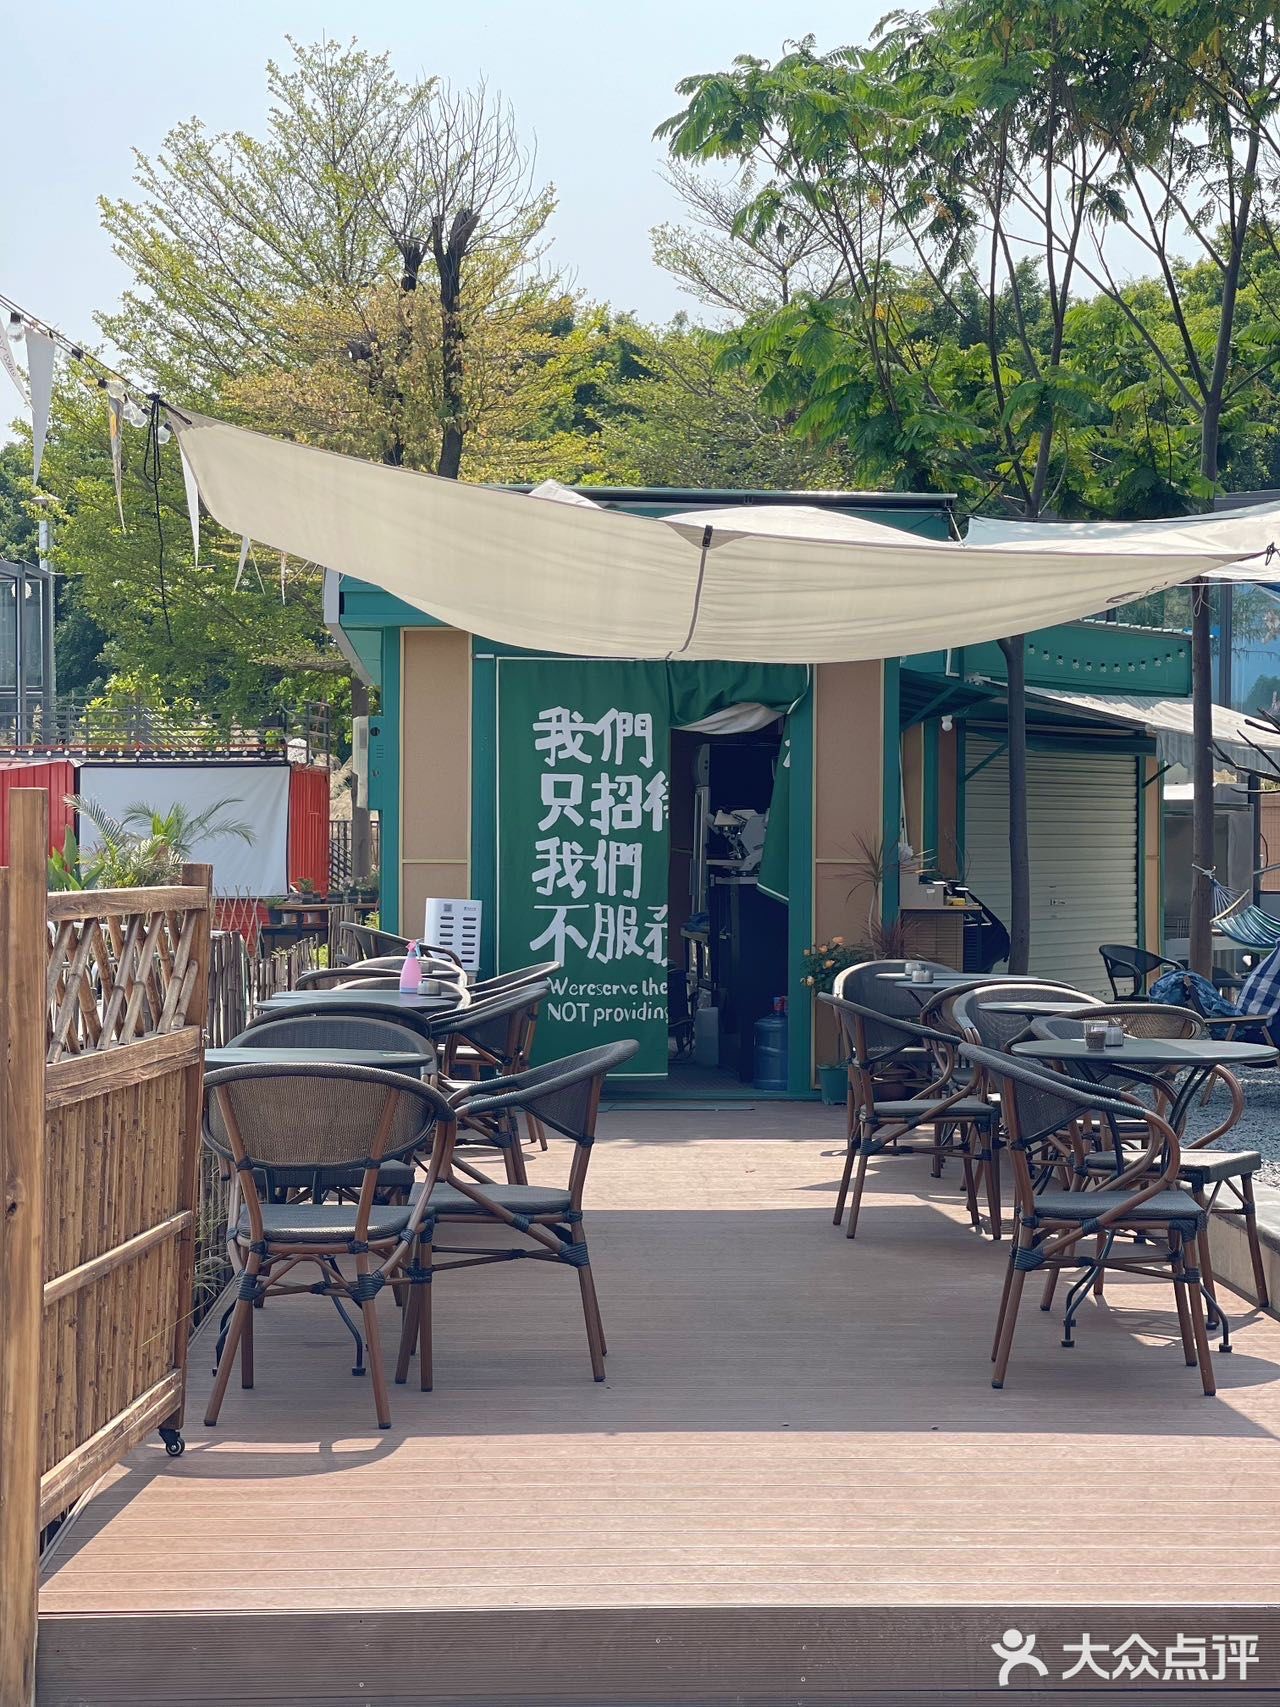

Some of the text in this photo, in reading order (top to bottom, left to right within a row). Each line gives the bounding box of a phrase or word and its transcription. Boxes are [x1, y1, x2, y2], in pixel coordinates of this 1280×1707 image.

[532, 706, 653, 768] 我們
[531, 836, 643, 899] 我們
[547, 1001, 590, 1022] NOT
